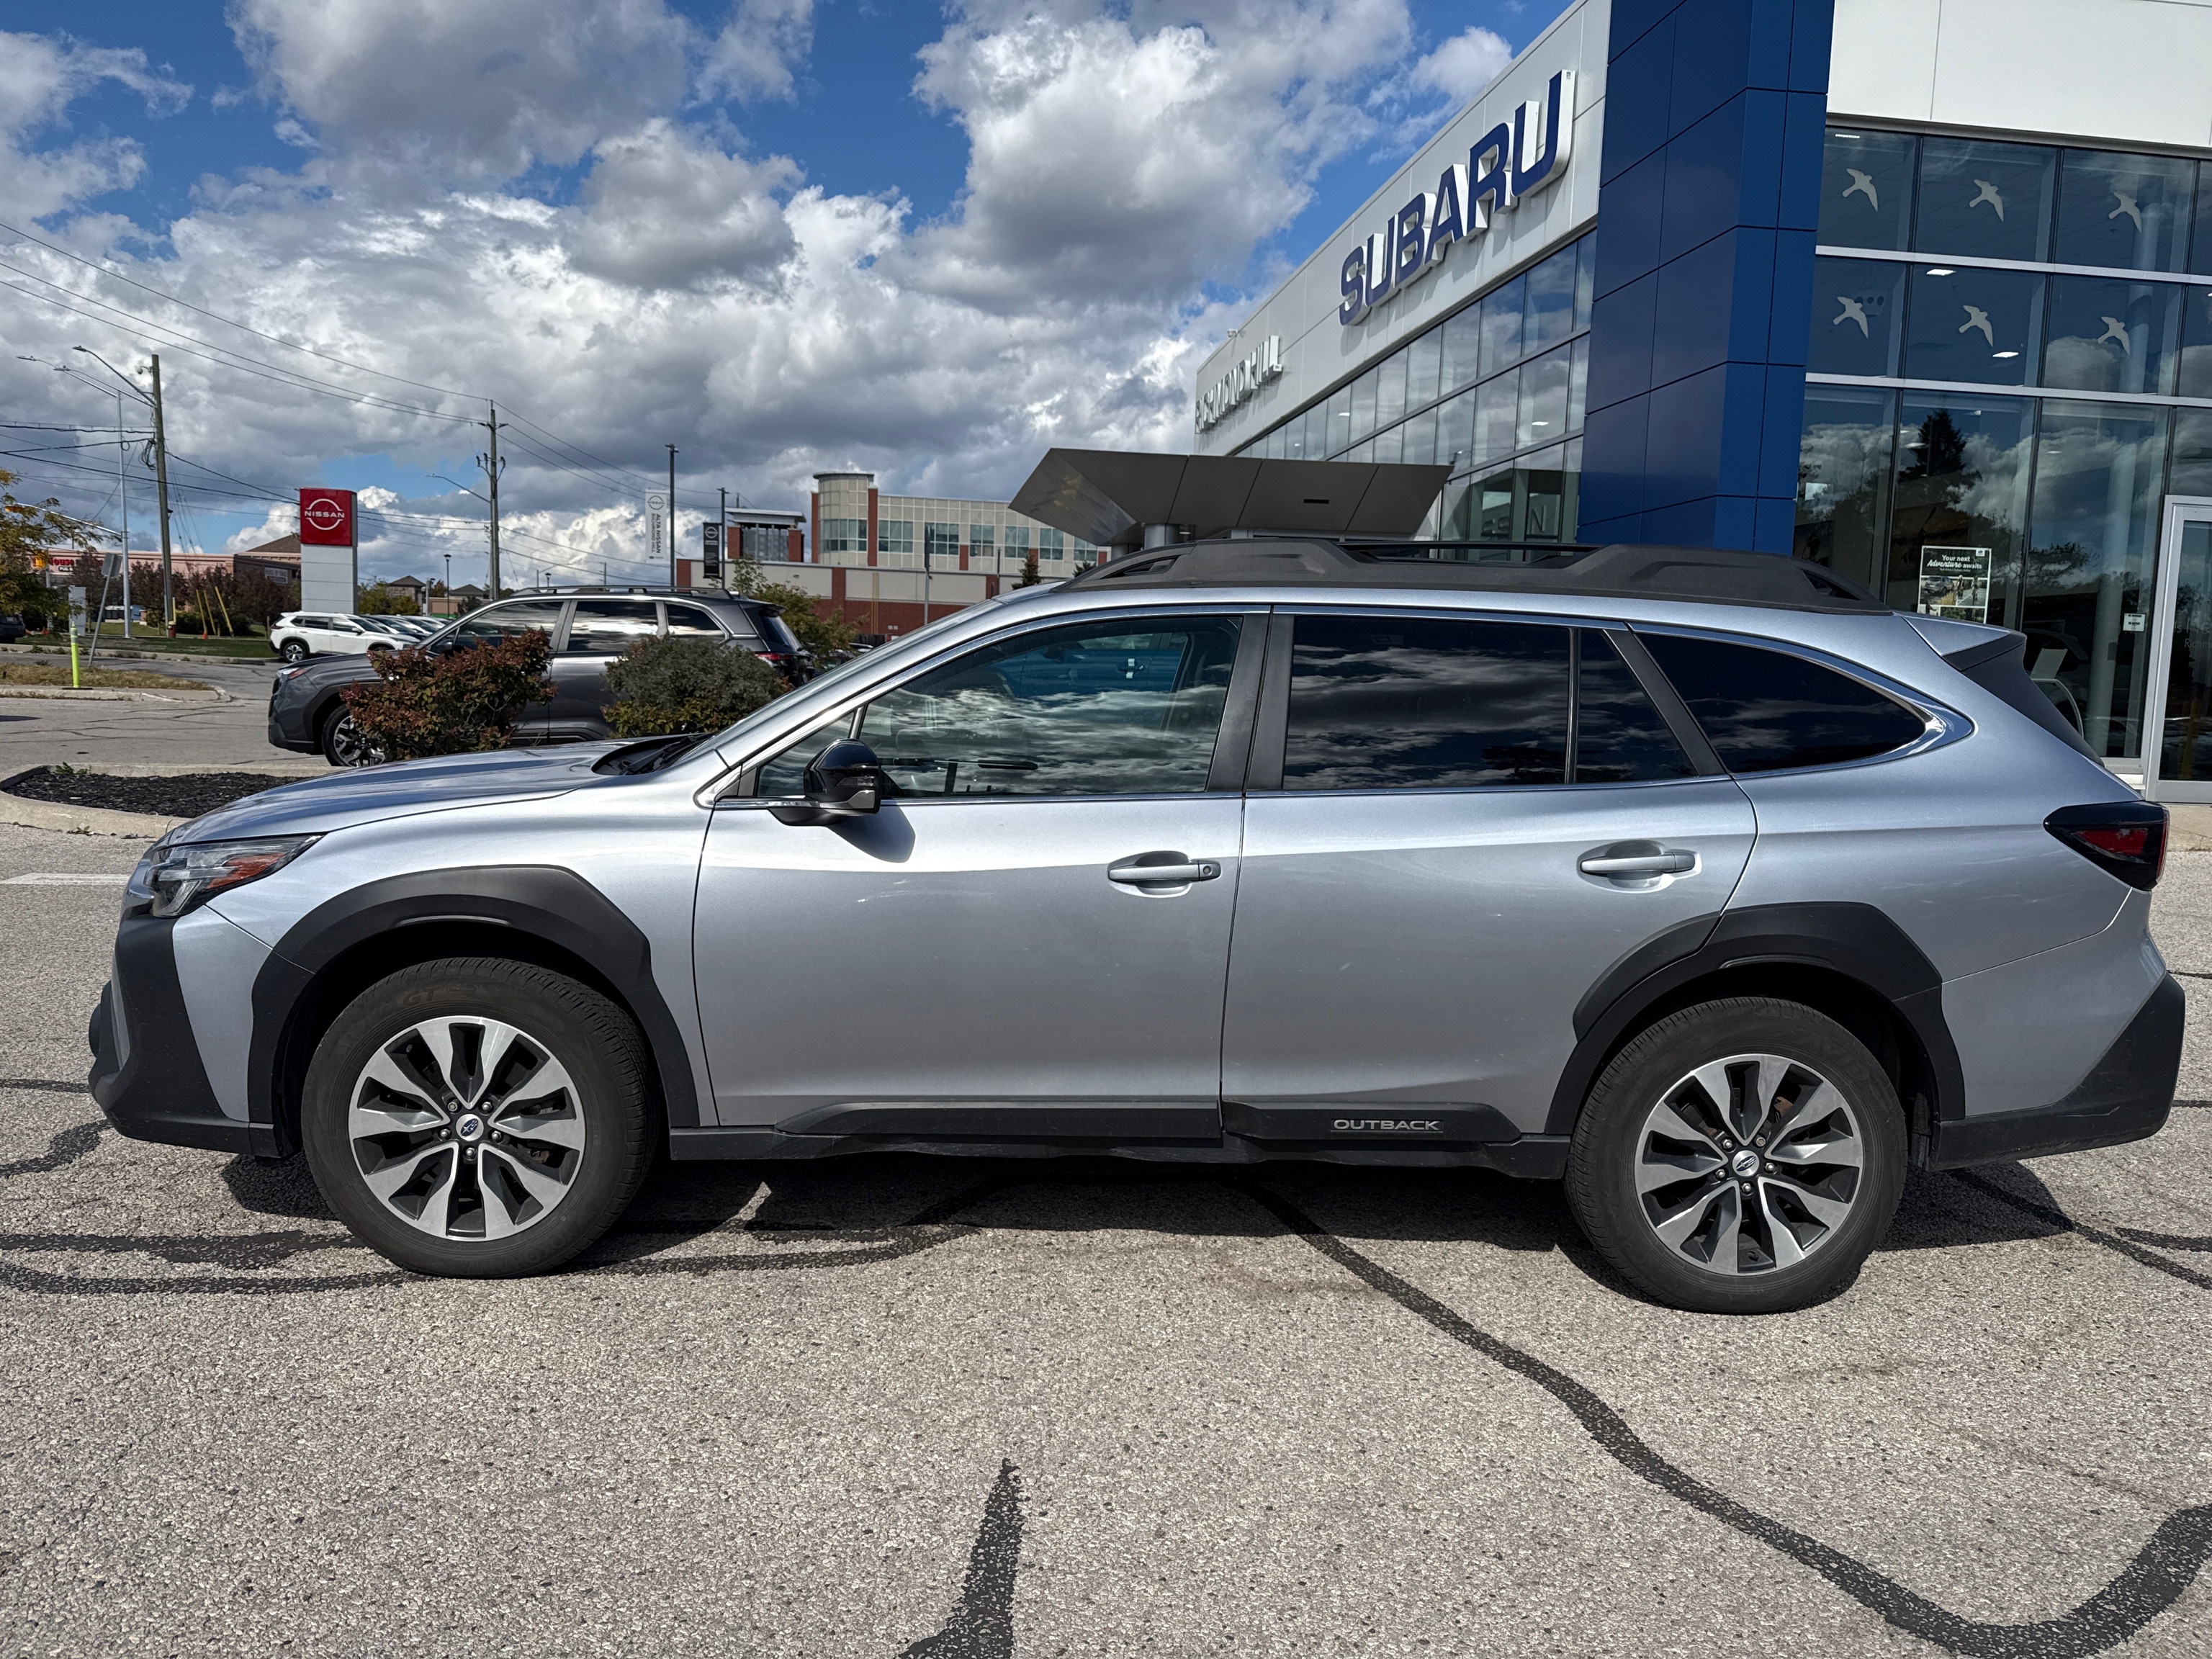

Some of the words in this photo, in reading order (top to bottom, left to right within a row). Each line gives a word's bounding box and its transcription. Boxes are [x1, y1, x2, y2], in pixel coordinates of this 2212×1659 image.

[1339, 69, 1575, 325] SUBARU
[1927, 559, 1962, 568] Adventure
[1334, 1119, 1440, 1130] OUTBACK
